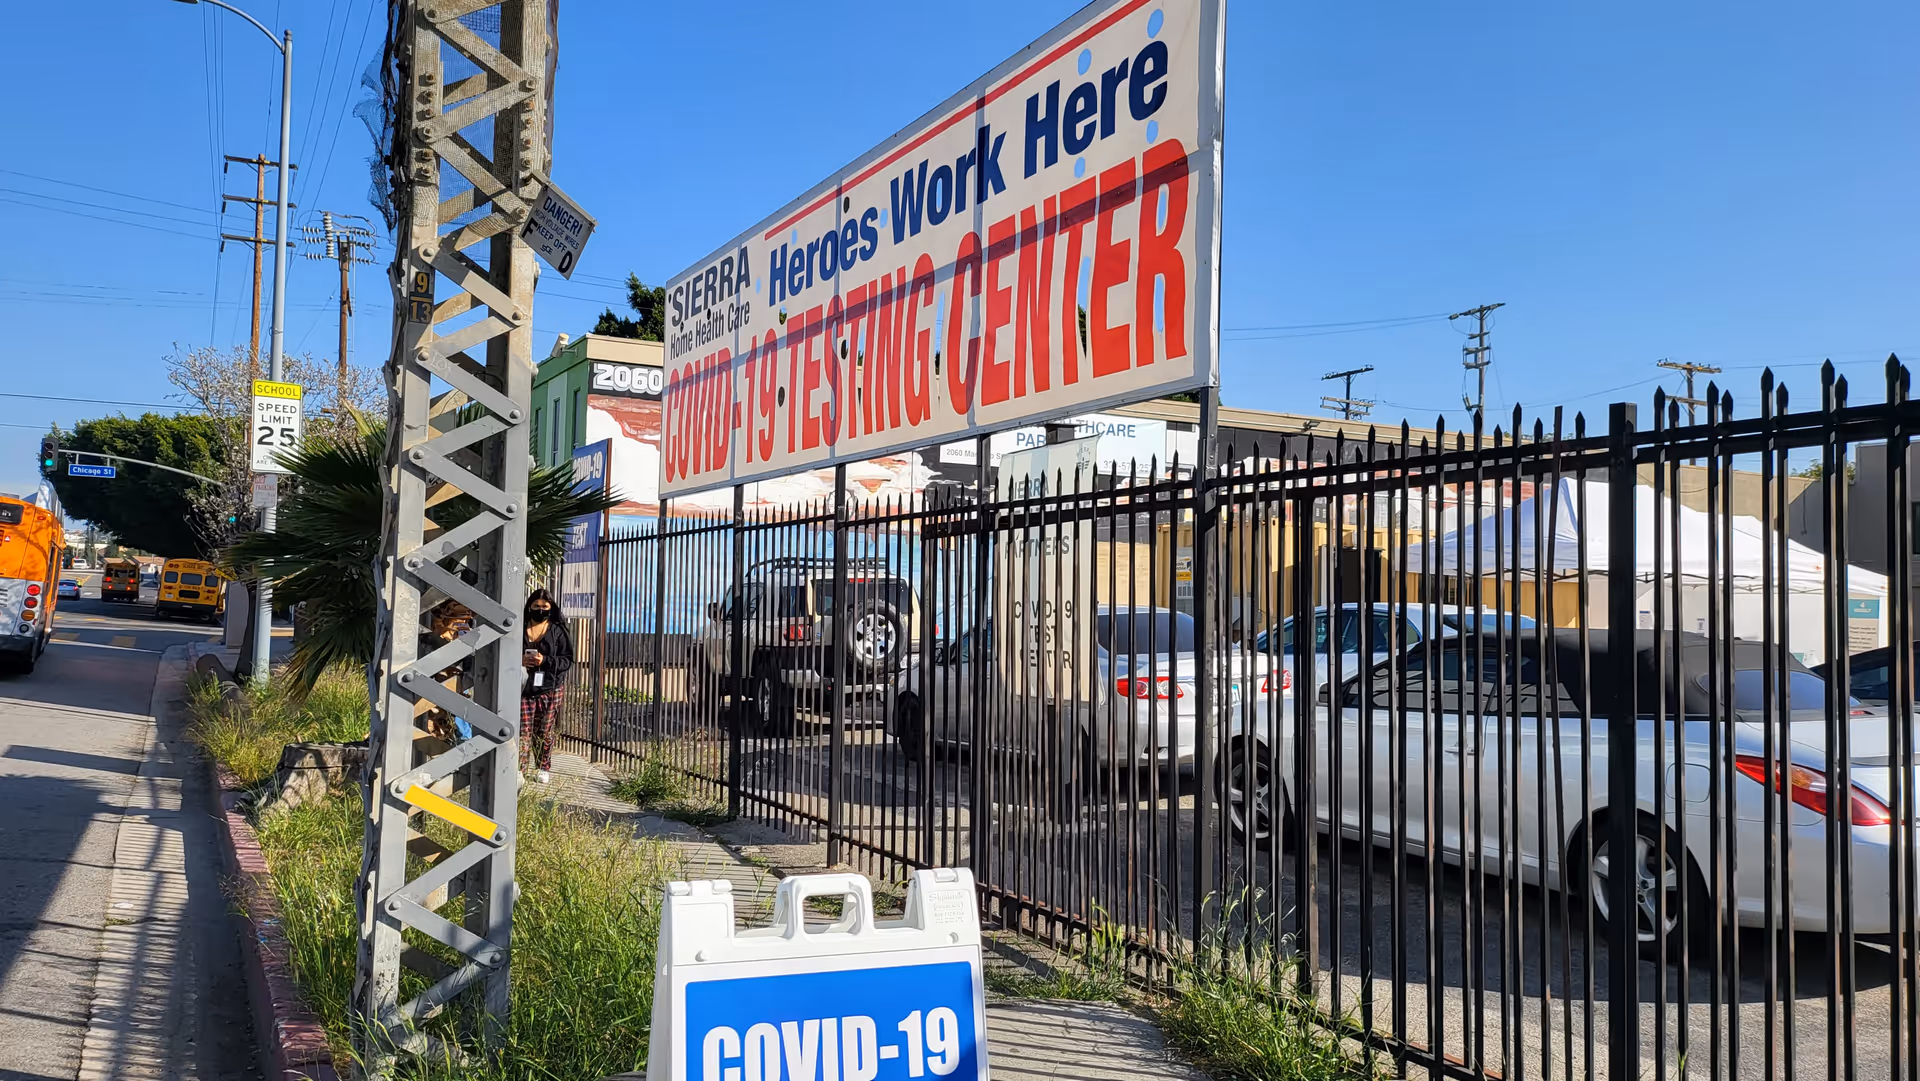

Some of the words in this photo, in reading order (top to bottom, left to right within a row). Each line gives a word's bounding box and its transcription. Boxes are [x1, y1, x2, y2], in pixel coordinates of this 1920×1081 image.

[768, 206, 878, 307] Heroes
[890, 123, 1007, 246] Work
[1024, 40, 1169, 179] Here
[521, 217, 538, 239] F
[543, 196, 583, 237] DANGER!
[536, 223, 554, 241] KEEP
[553, 238, 567, 253] OFF
[545, 217, 565, 238] VOLTAGE
[565, 233, 580, 250] WIRES
[557, 250, 573, 274] D
[417, 272, 428, 293] 9
[671, 246, 751, 327] SIERRA
[411, 302, 431, 322] 13
[665, 328, 778, 484] COVID-19
[786, 253, 936, 454] TESTING
[947, 138, 1189, 415] CENTER
[670, 328, 693, 360] Home
[695, 309, 724, 348] Health
[727, 301, 750, 333] Care
[257, 384, 298, 397] SCHOOL
[593, 363, 663, 395] 2060
[258, 403, 297, 414] SPEED
[261, 414, 292, 425] LIMIT
[257, 426, 295, 447] 25
[946, 448, 963, 457] 2060
[72, 466, 101, 476] Chicago
[703, 1006, 960, 1081] COVID-19
